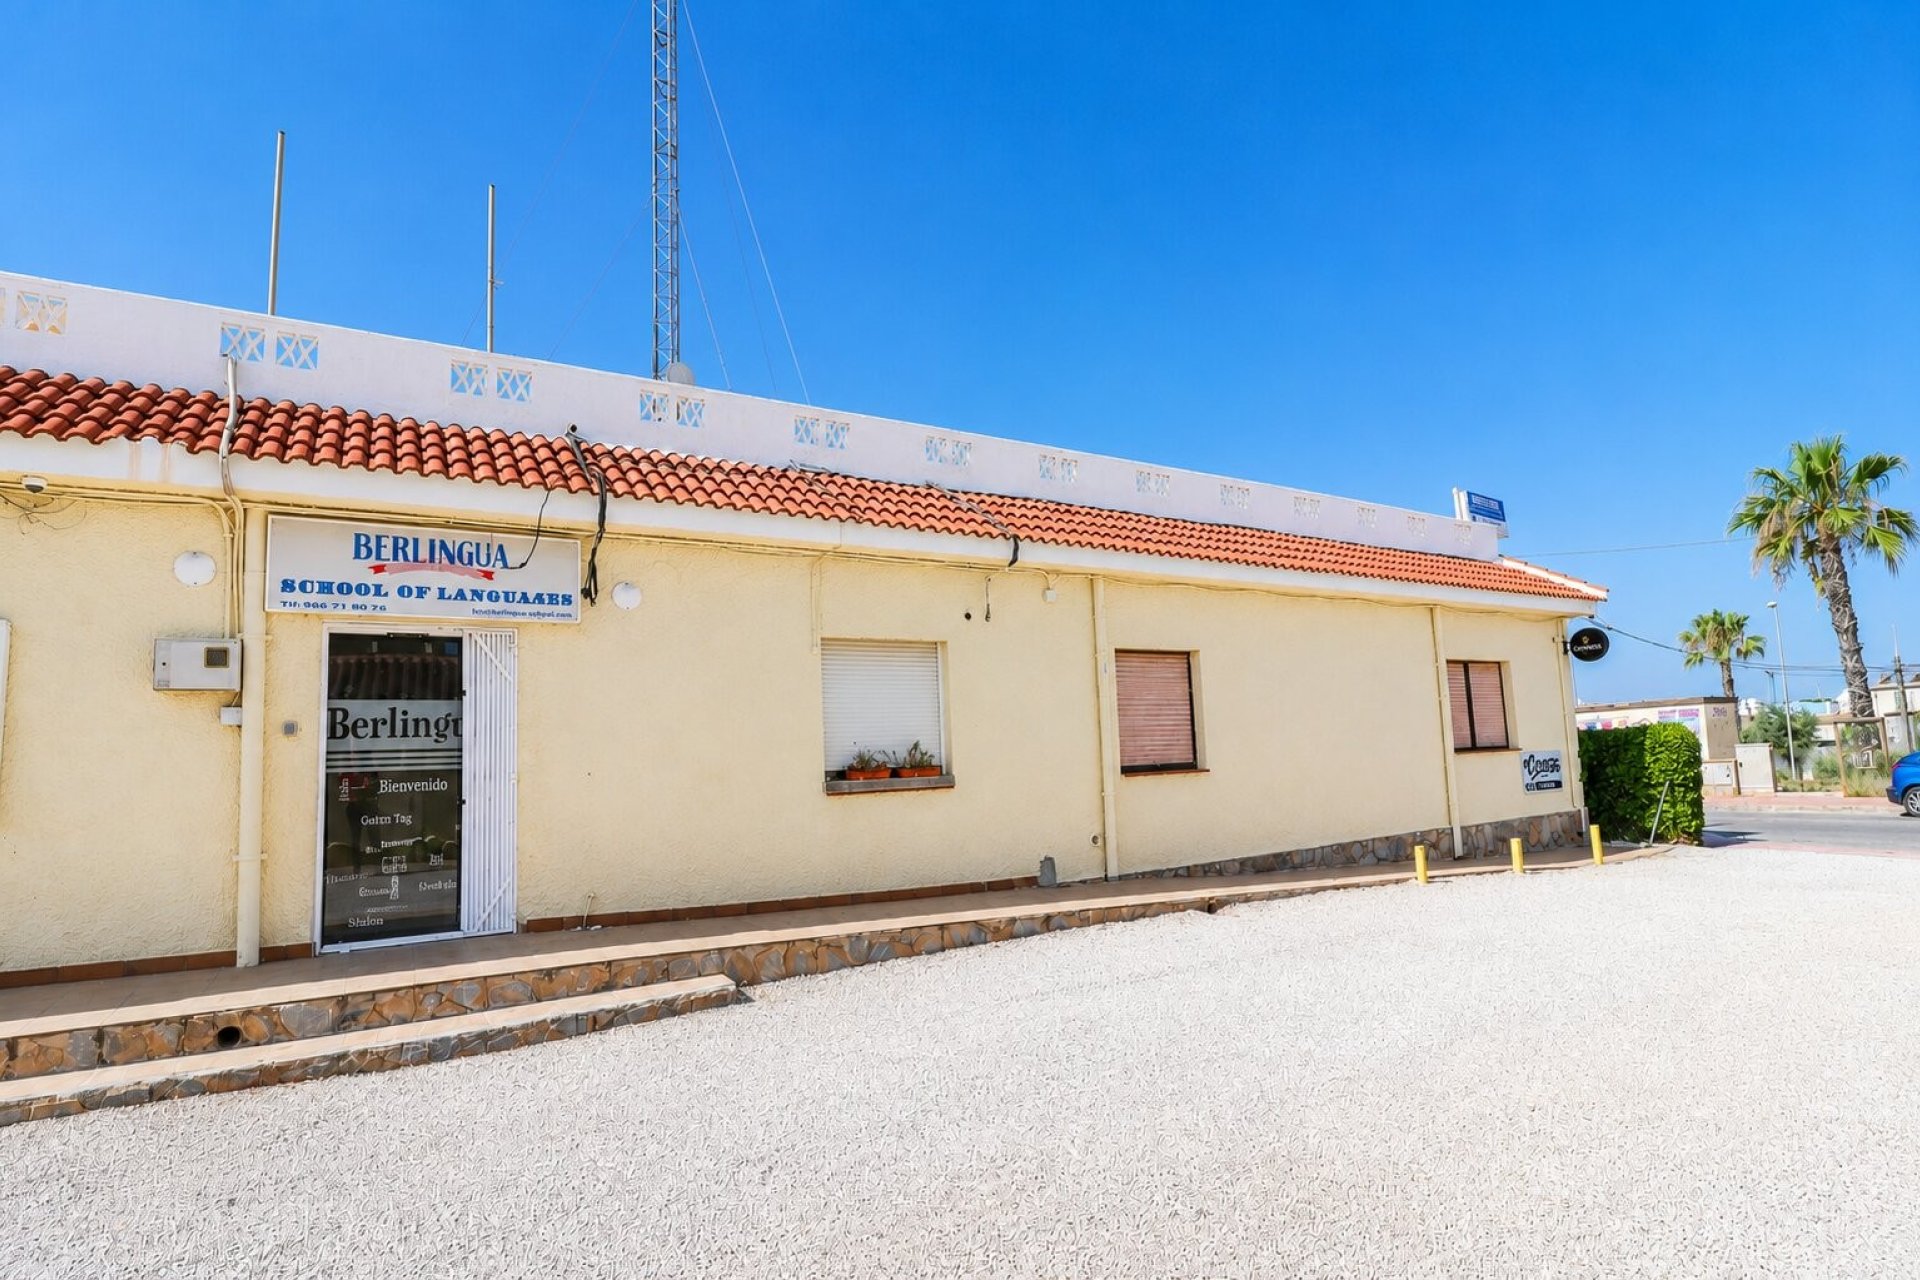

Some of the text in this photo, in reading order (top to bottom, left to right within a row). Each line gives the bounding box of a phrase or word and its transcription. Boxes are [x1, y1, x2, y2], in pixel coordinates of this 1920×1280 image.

[353, 532, 509, 569] BERLINGUA
[280, 578, 389, 598] SCHOOL
[397, 584, 431, 599] OF
[379, 777, 448, 793] Bienvenido
